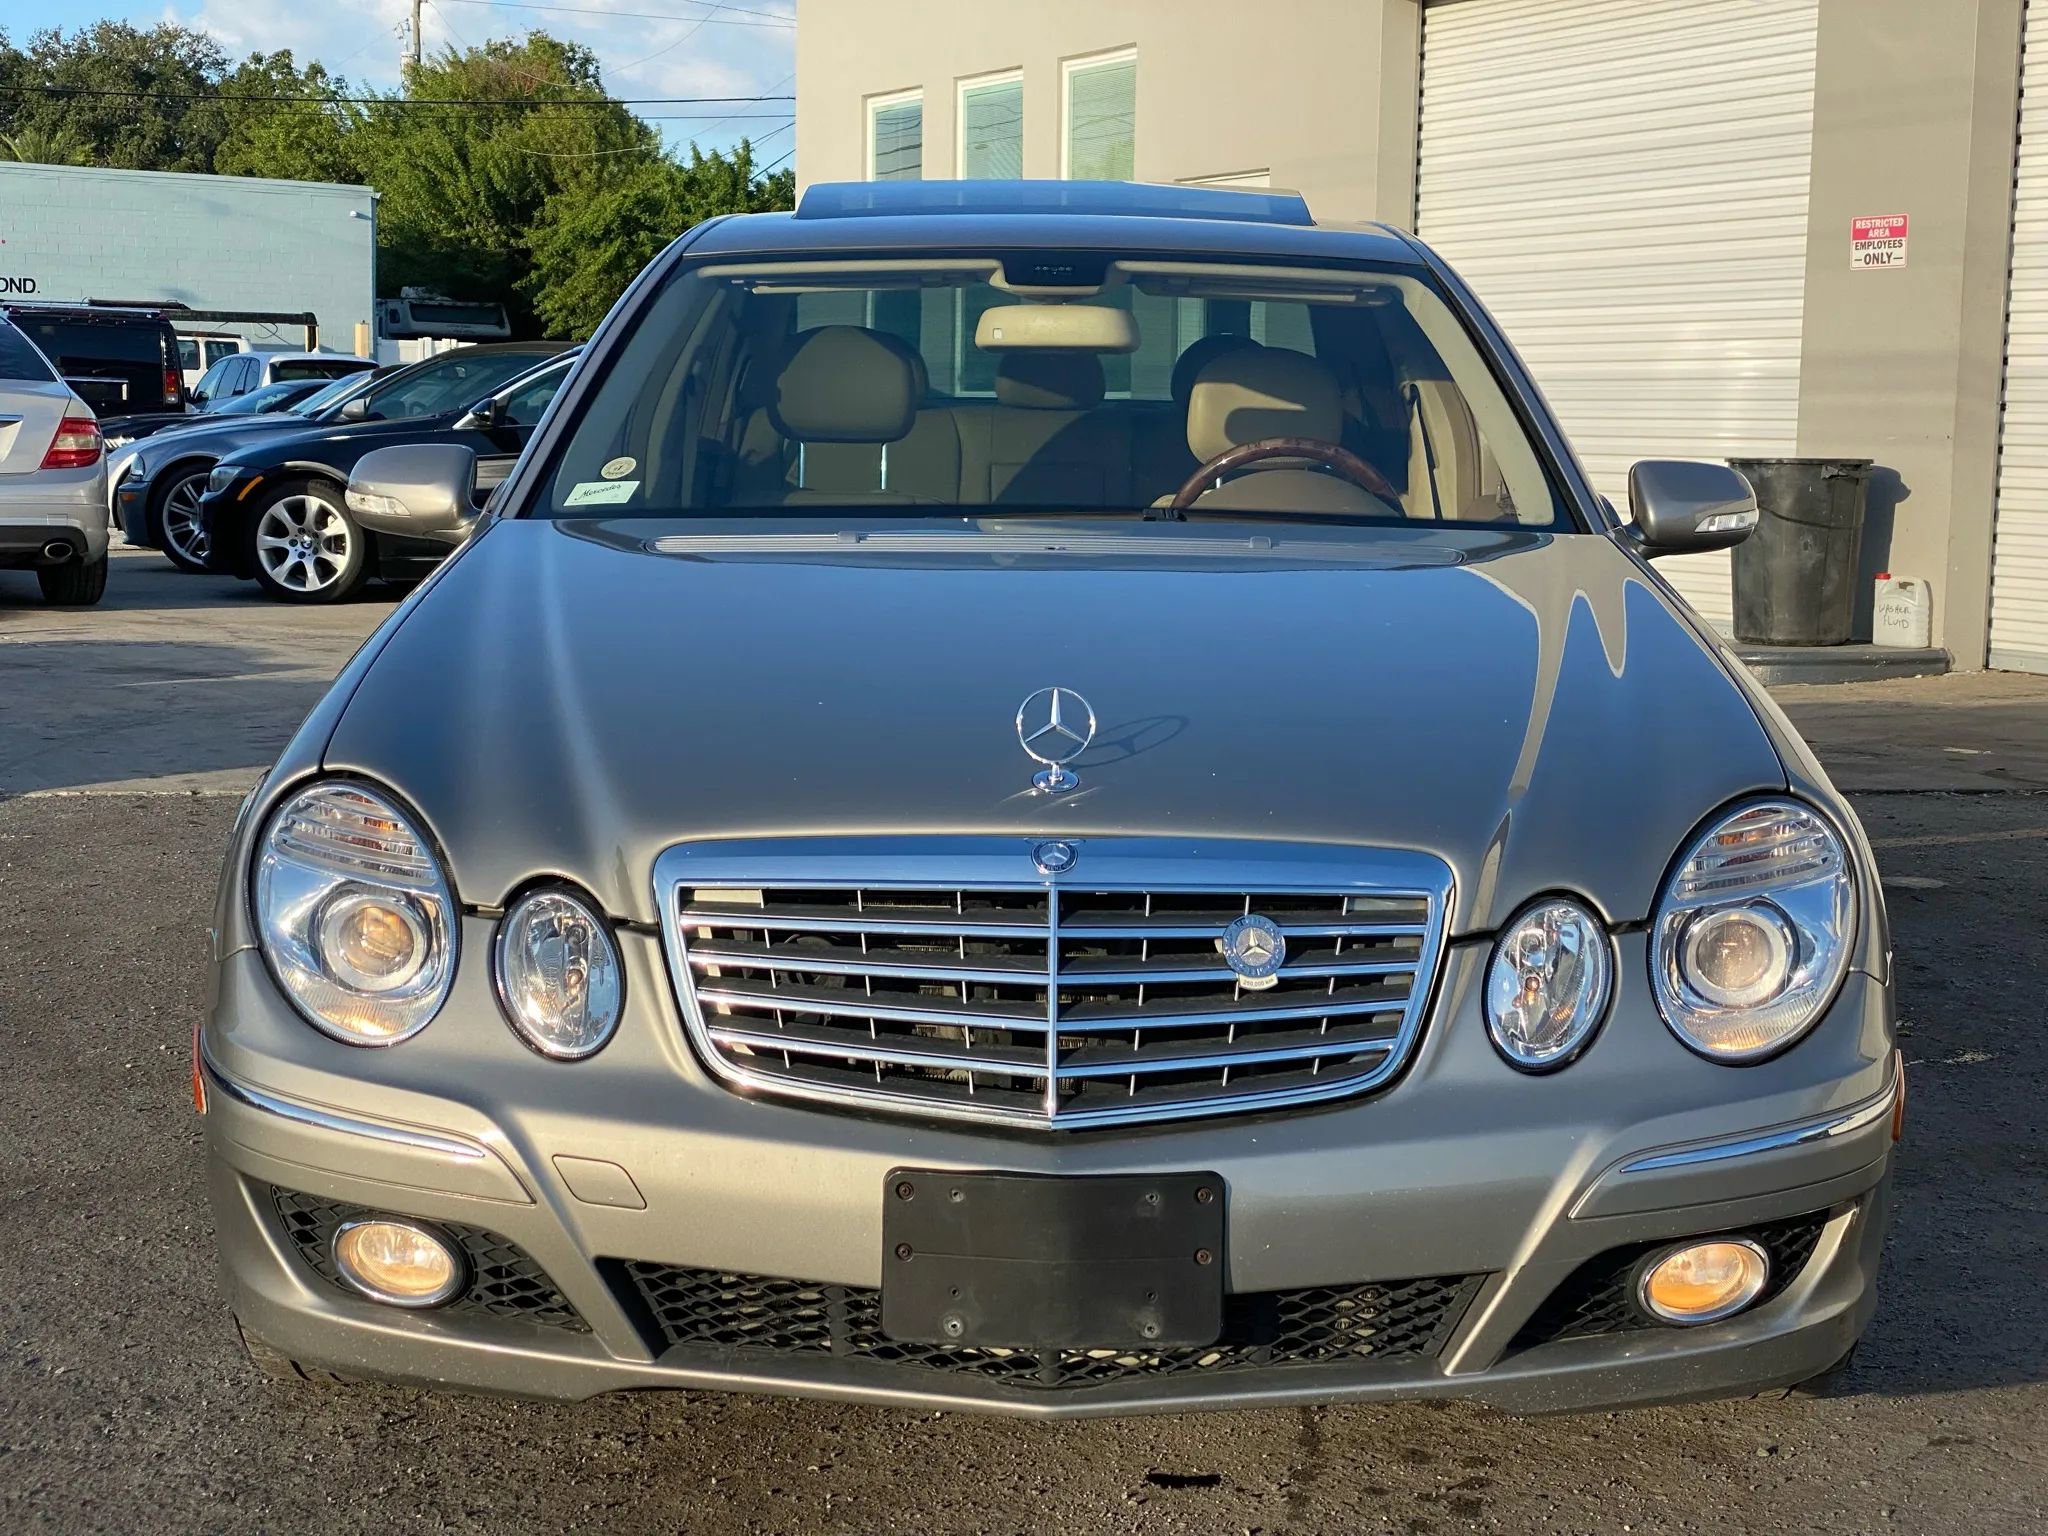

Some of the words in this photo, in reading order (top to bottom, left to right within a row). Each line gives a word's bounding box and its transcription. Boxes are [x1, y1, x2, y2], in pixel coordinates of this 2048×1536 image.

[1855, 217, 1904, 229] RESTRICTED
[1868, 228, 1890, 238] AREA
[1854, 239, 1904, 251] EMPLOYEES
[1884, 614, 1910, 629] FLUID
